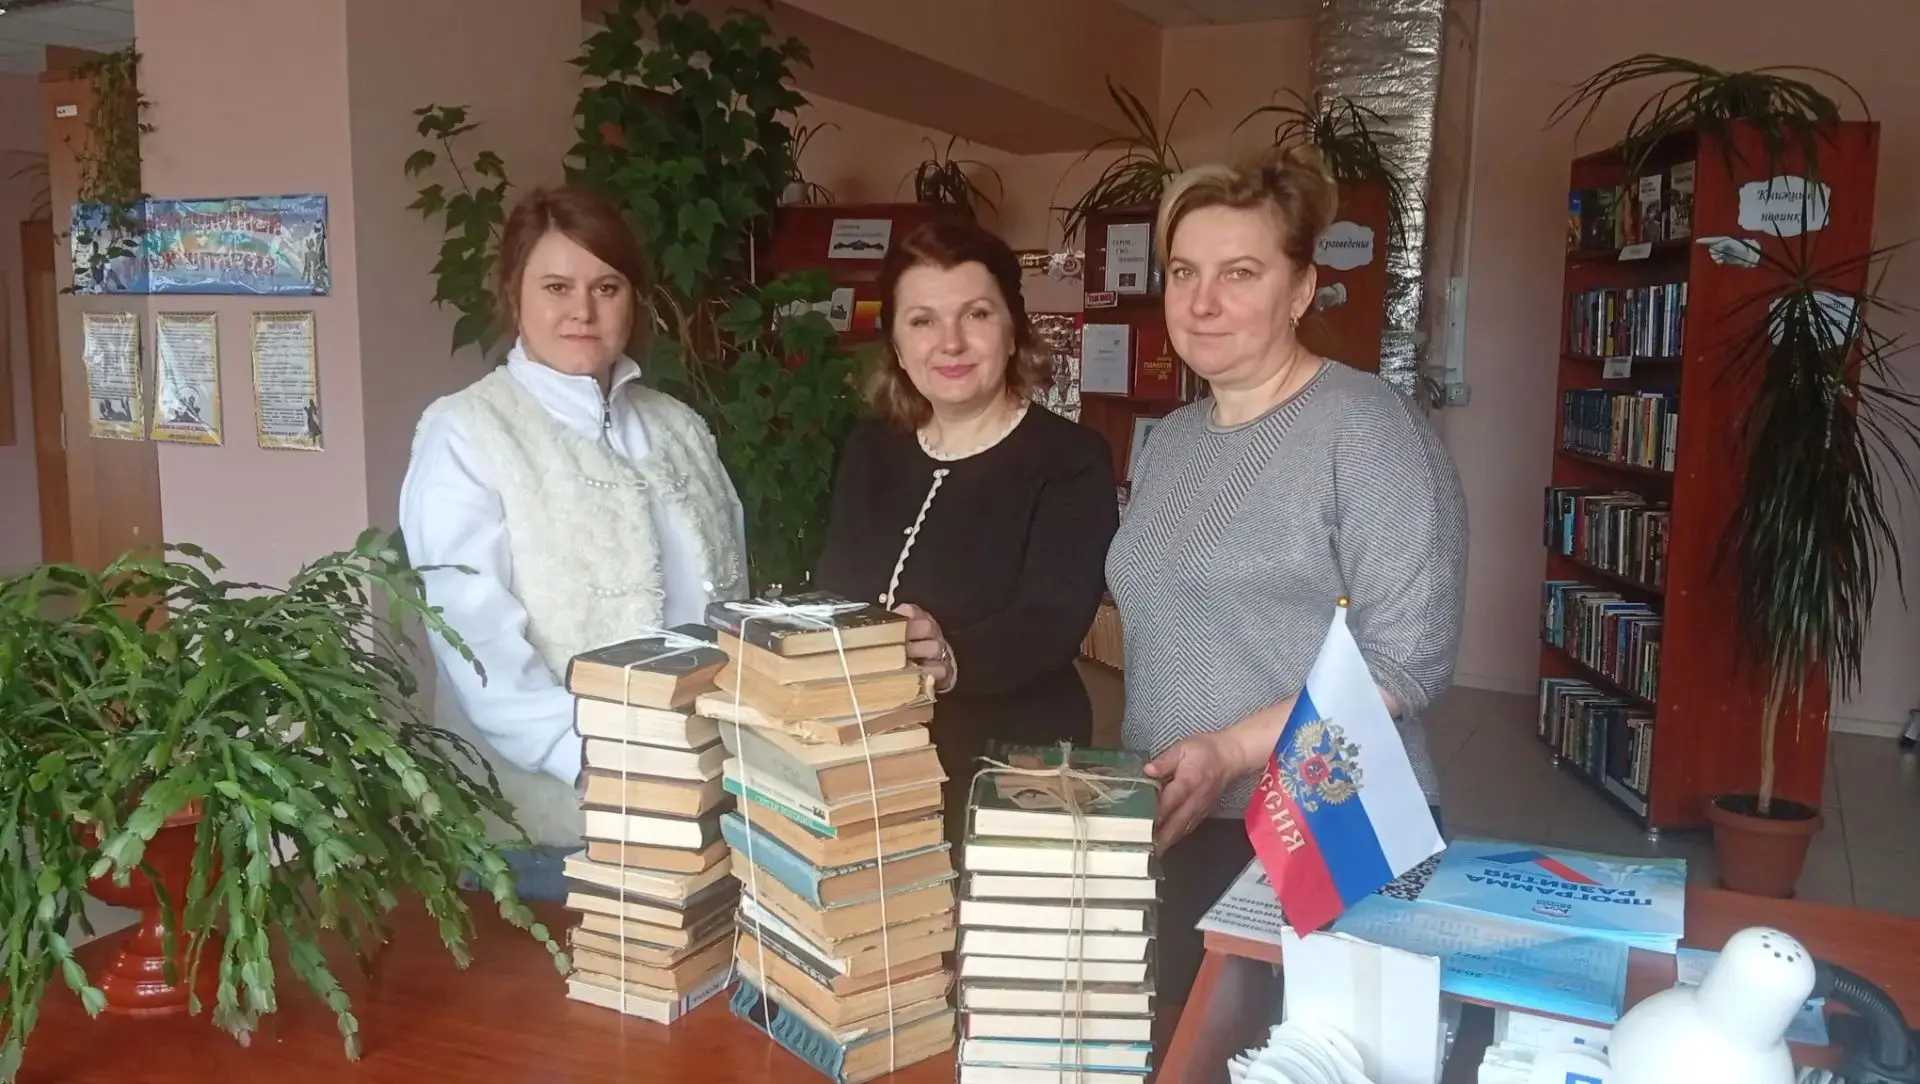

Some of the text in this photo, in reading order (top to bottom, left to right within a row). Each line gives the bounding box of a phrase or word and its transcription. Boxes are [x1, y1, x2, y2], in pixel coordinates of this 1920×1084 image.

[1761, 212, 1801, 224] новинк
[1318, 236, 1370, 251] Краеведение
[1260, 764, 1306, 854] ССИЯ
[1464, 873, 1653, 906] ПРОГРАММА
[1484, 868, 1637, 898] РАЗВИТИЯ
